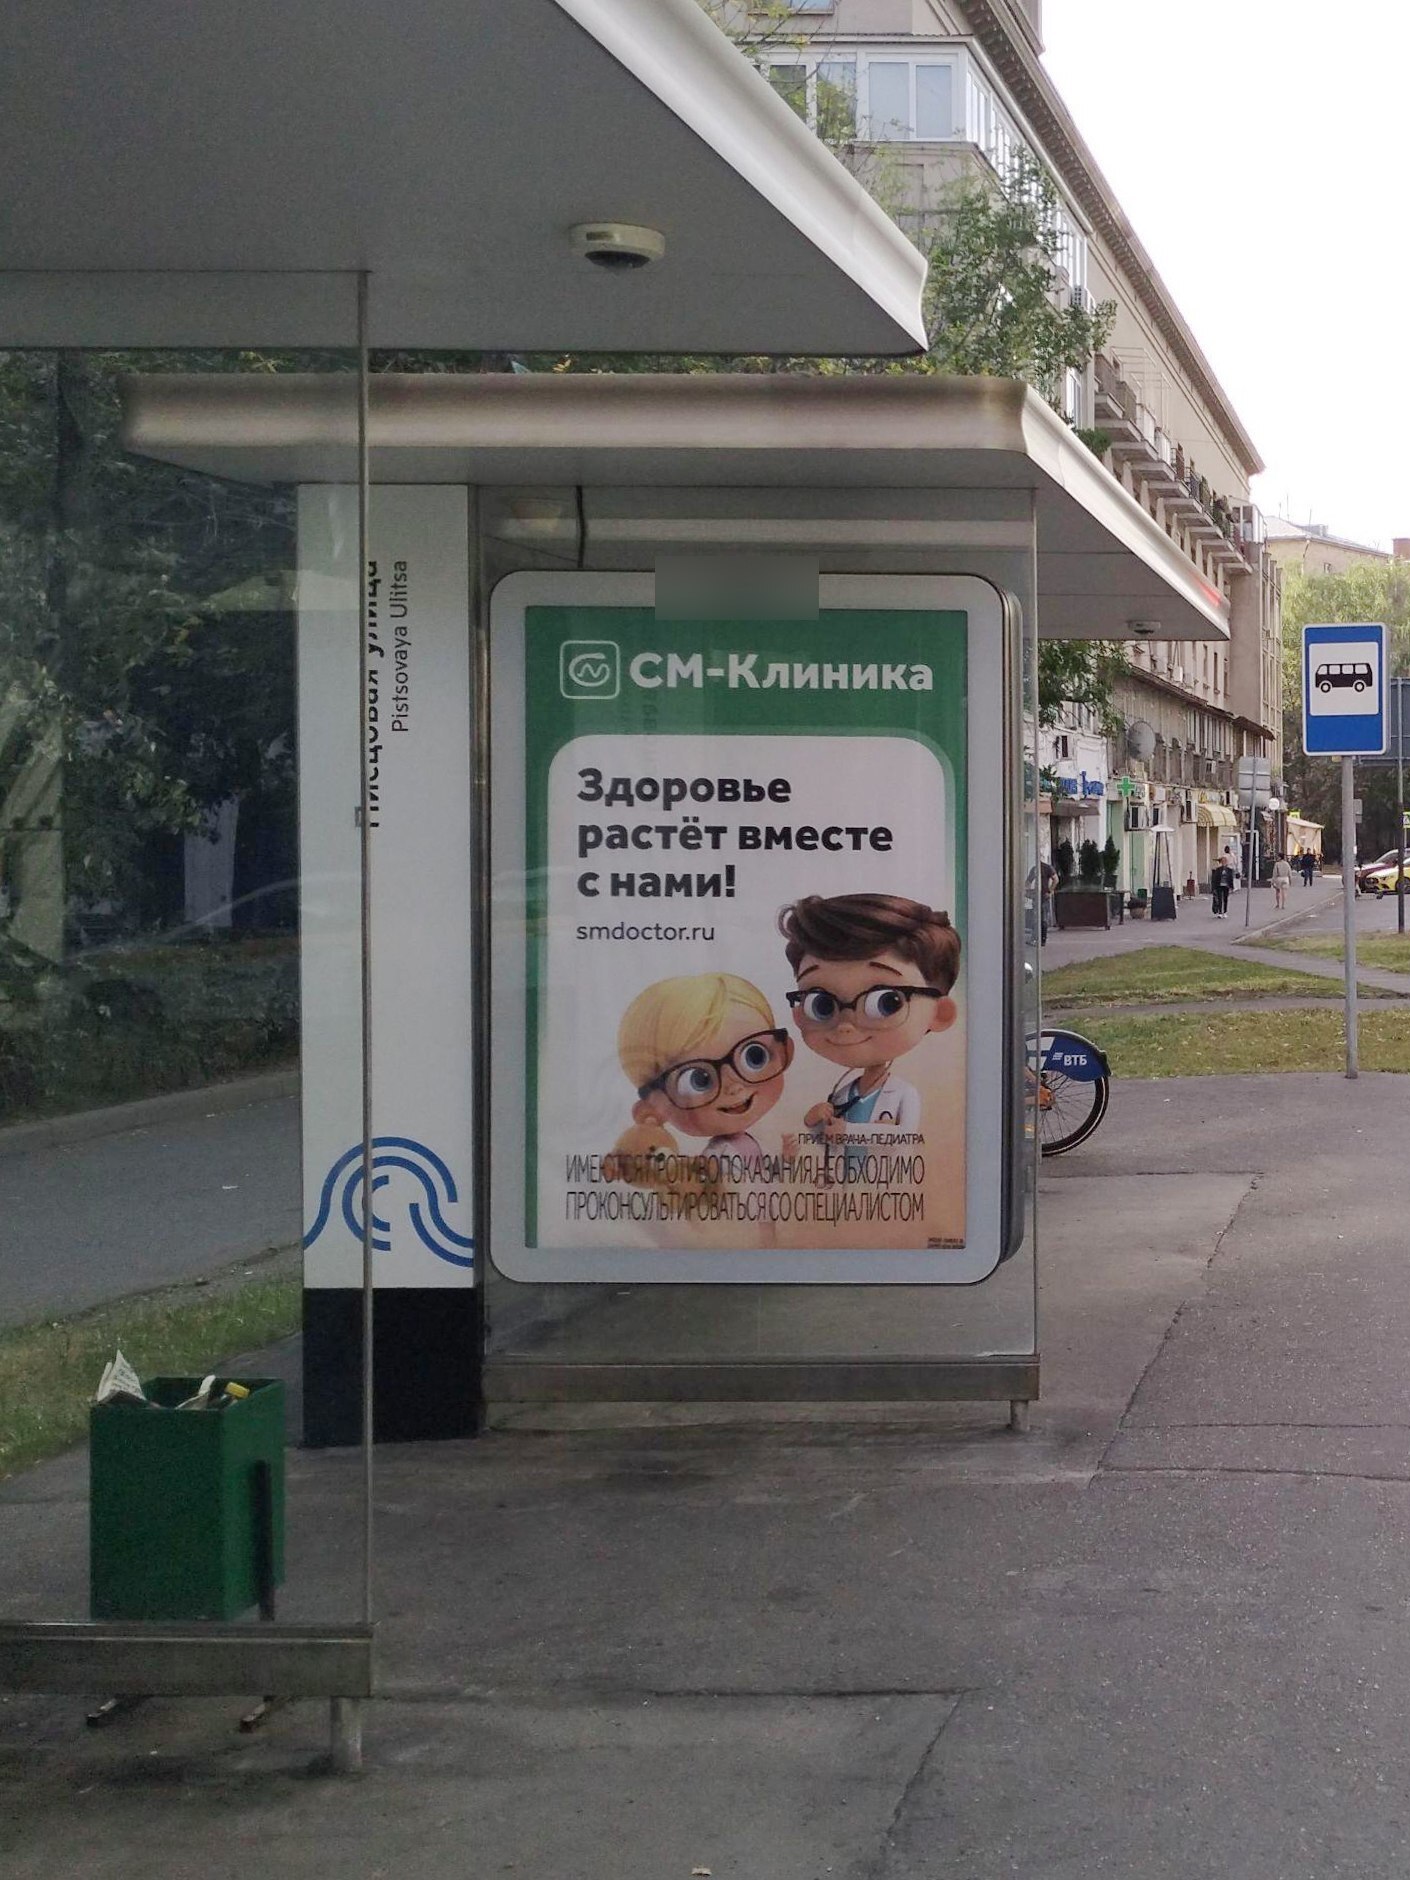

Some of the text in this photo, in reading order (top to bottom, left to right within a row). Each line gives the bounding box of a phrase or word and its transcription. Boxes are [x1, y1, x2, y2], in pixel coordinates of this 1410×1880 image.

[389, 560, 412, 732] Pistsovaya Ulitsa
[629, 651, 934, 691] СМ-Клиника
[576, 767, 792, 812] Здоровье
[577, 815, 893, 858] растёт вместе
[577, 864, 736, 898] с нами!
[576, 922, 716, 942] smdoctor.ru
[1063, 1054, 1088, 1067] ВТБ
[835, 1133, 925, 1146] ВРАЧА-ПЕДИАТРА
[566, 1154, 643, 1184] ИМЕЮТСЯ
[816, 1154, 926, 1190] НЕОБХОДИМО
[566, 1191, 926, 1228] ПРОКОНСУЛЬТИРОВАТЬСЯ СО СПЕЦИАЛИСТОМ
